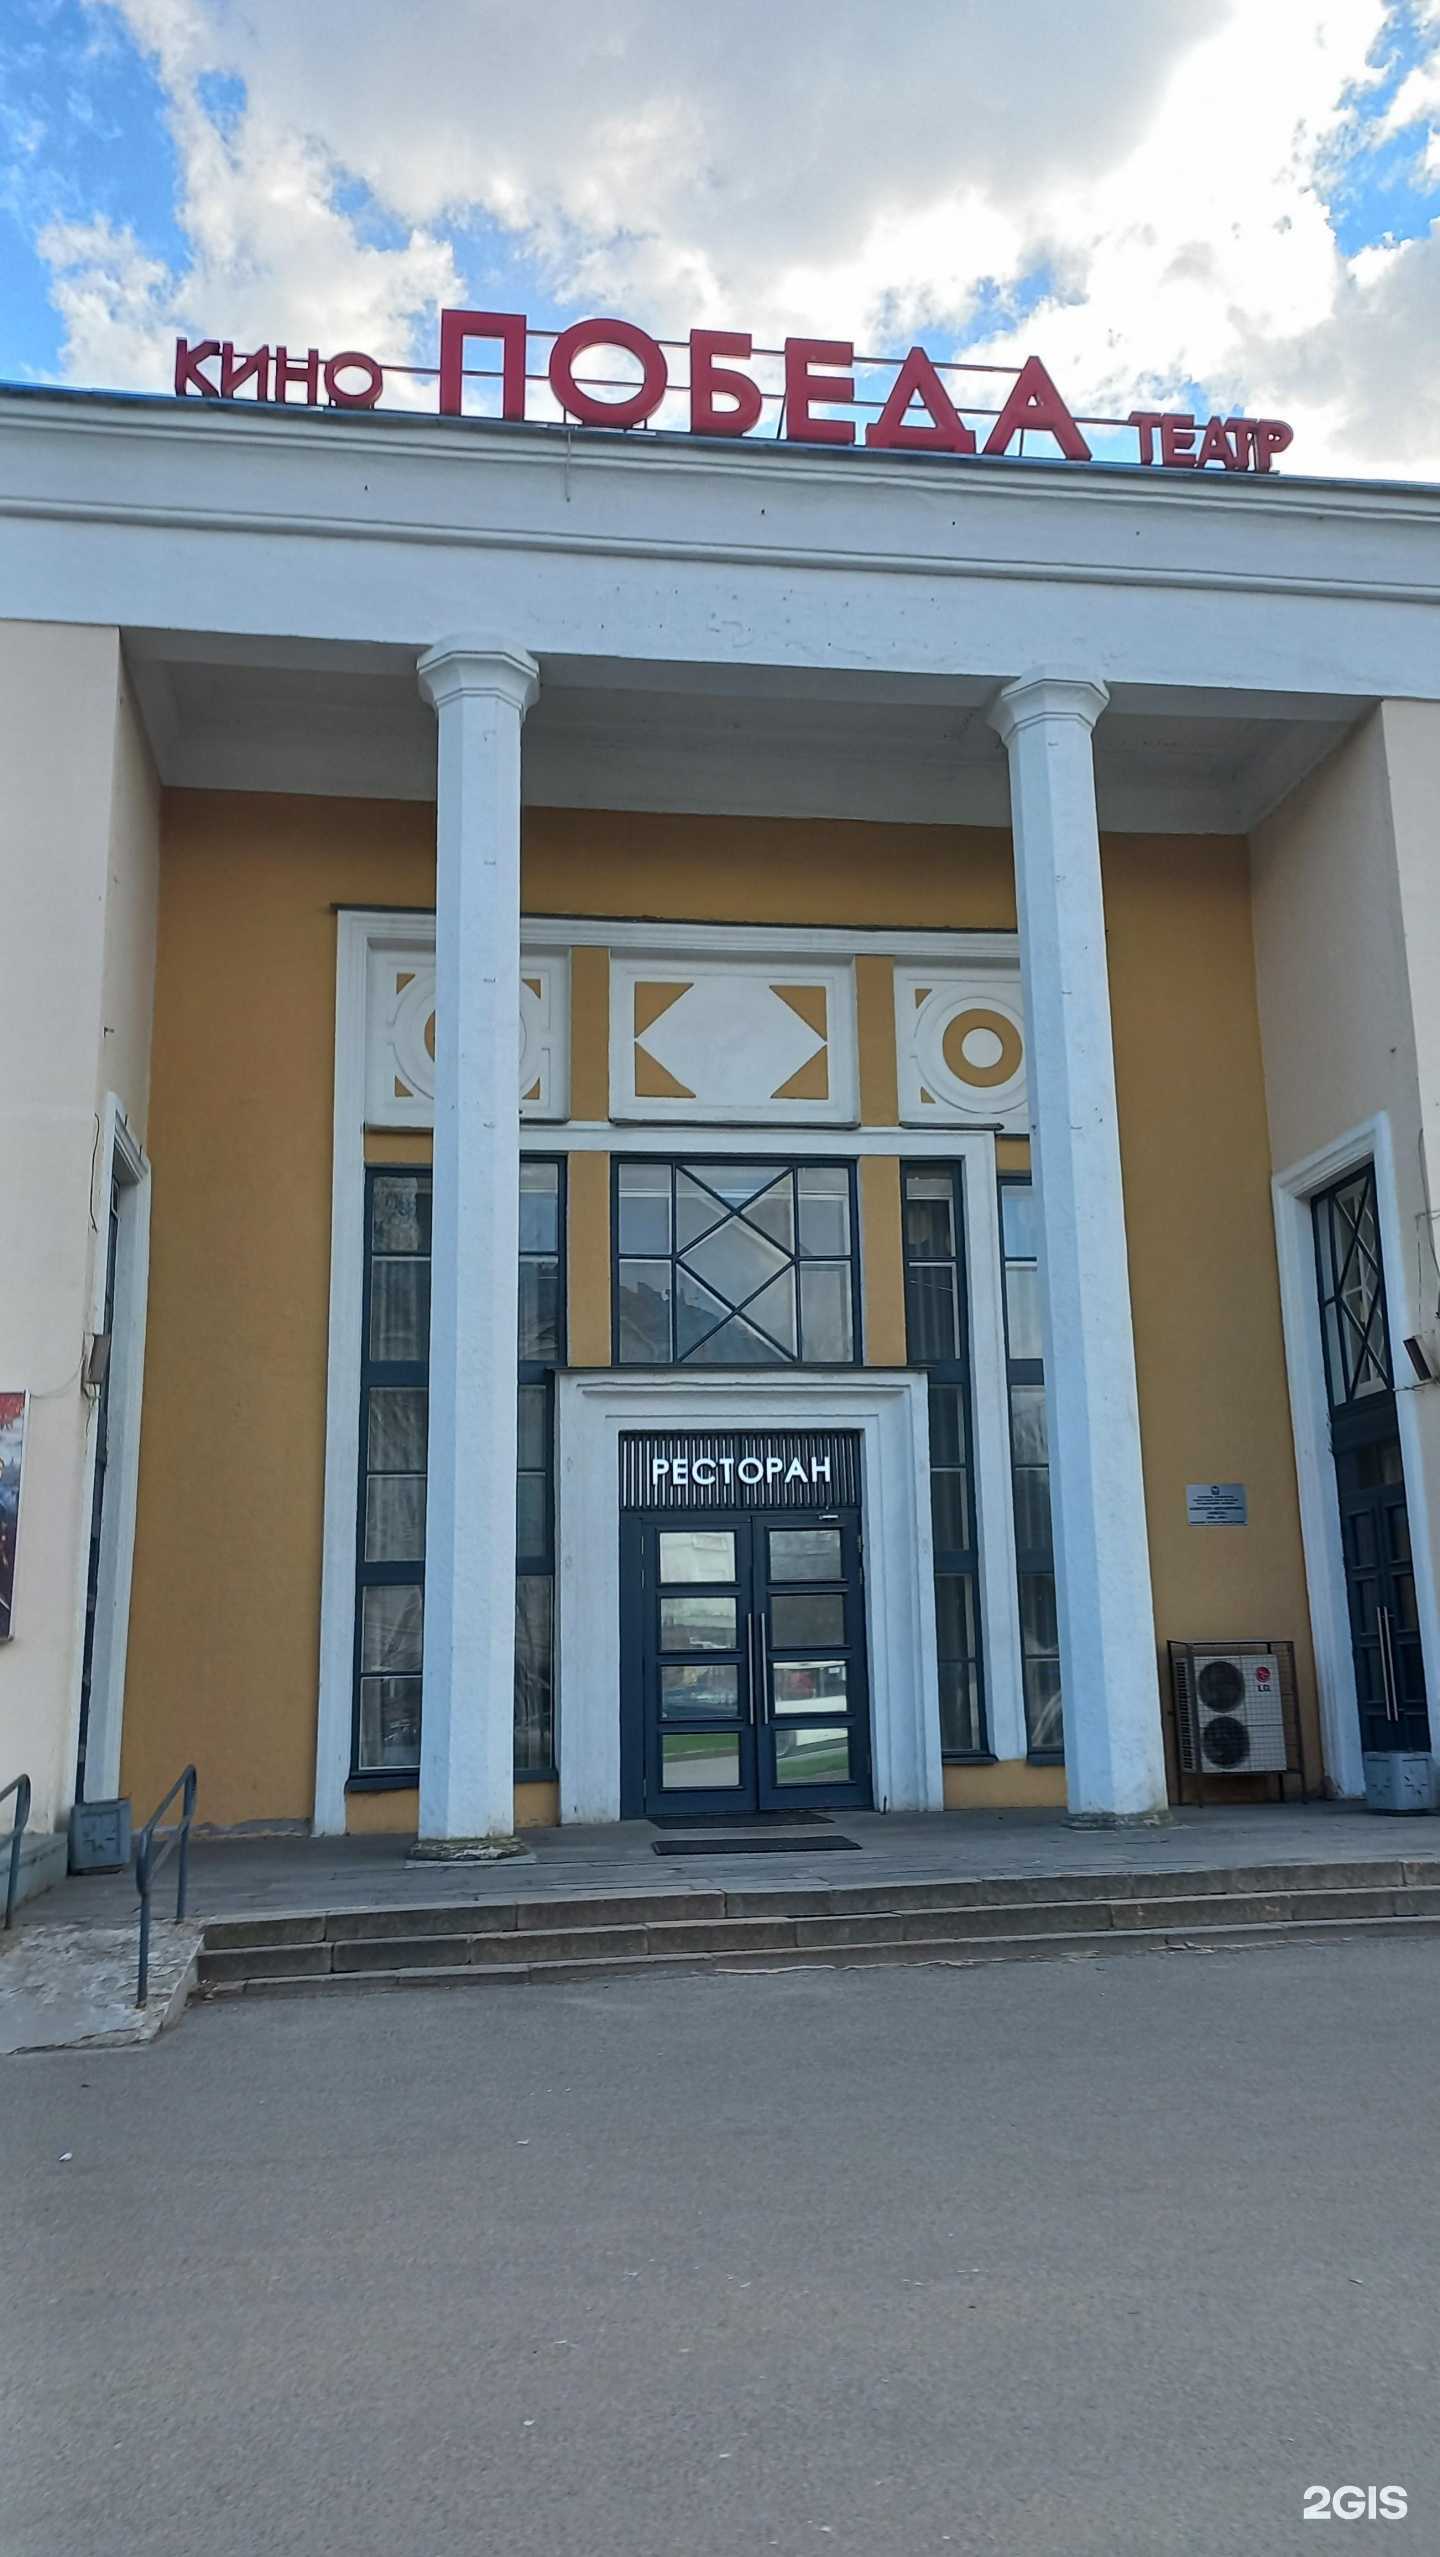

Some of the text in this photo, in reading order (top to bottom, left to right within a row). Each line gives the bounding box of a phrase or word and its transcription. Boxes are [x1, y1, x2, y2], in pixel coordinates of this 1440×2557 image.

[174, 308, 1294, 473] КИНО ПОБЕДА ТЕАТР
[652, 1456, 831, 1486] РЕСТОРАН
